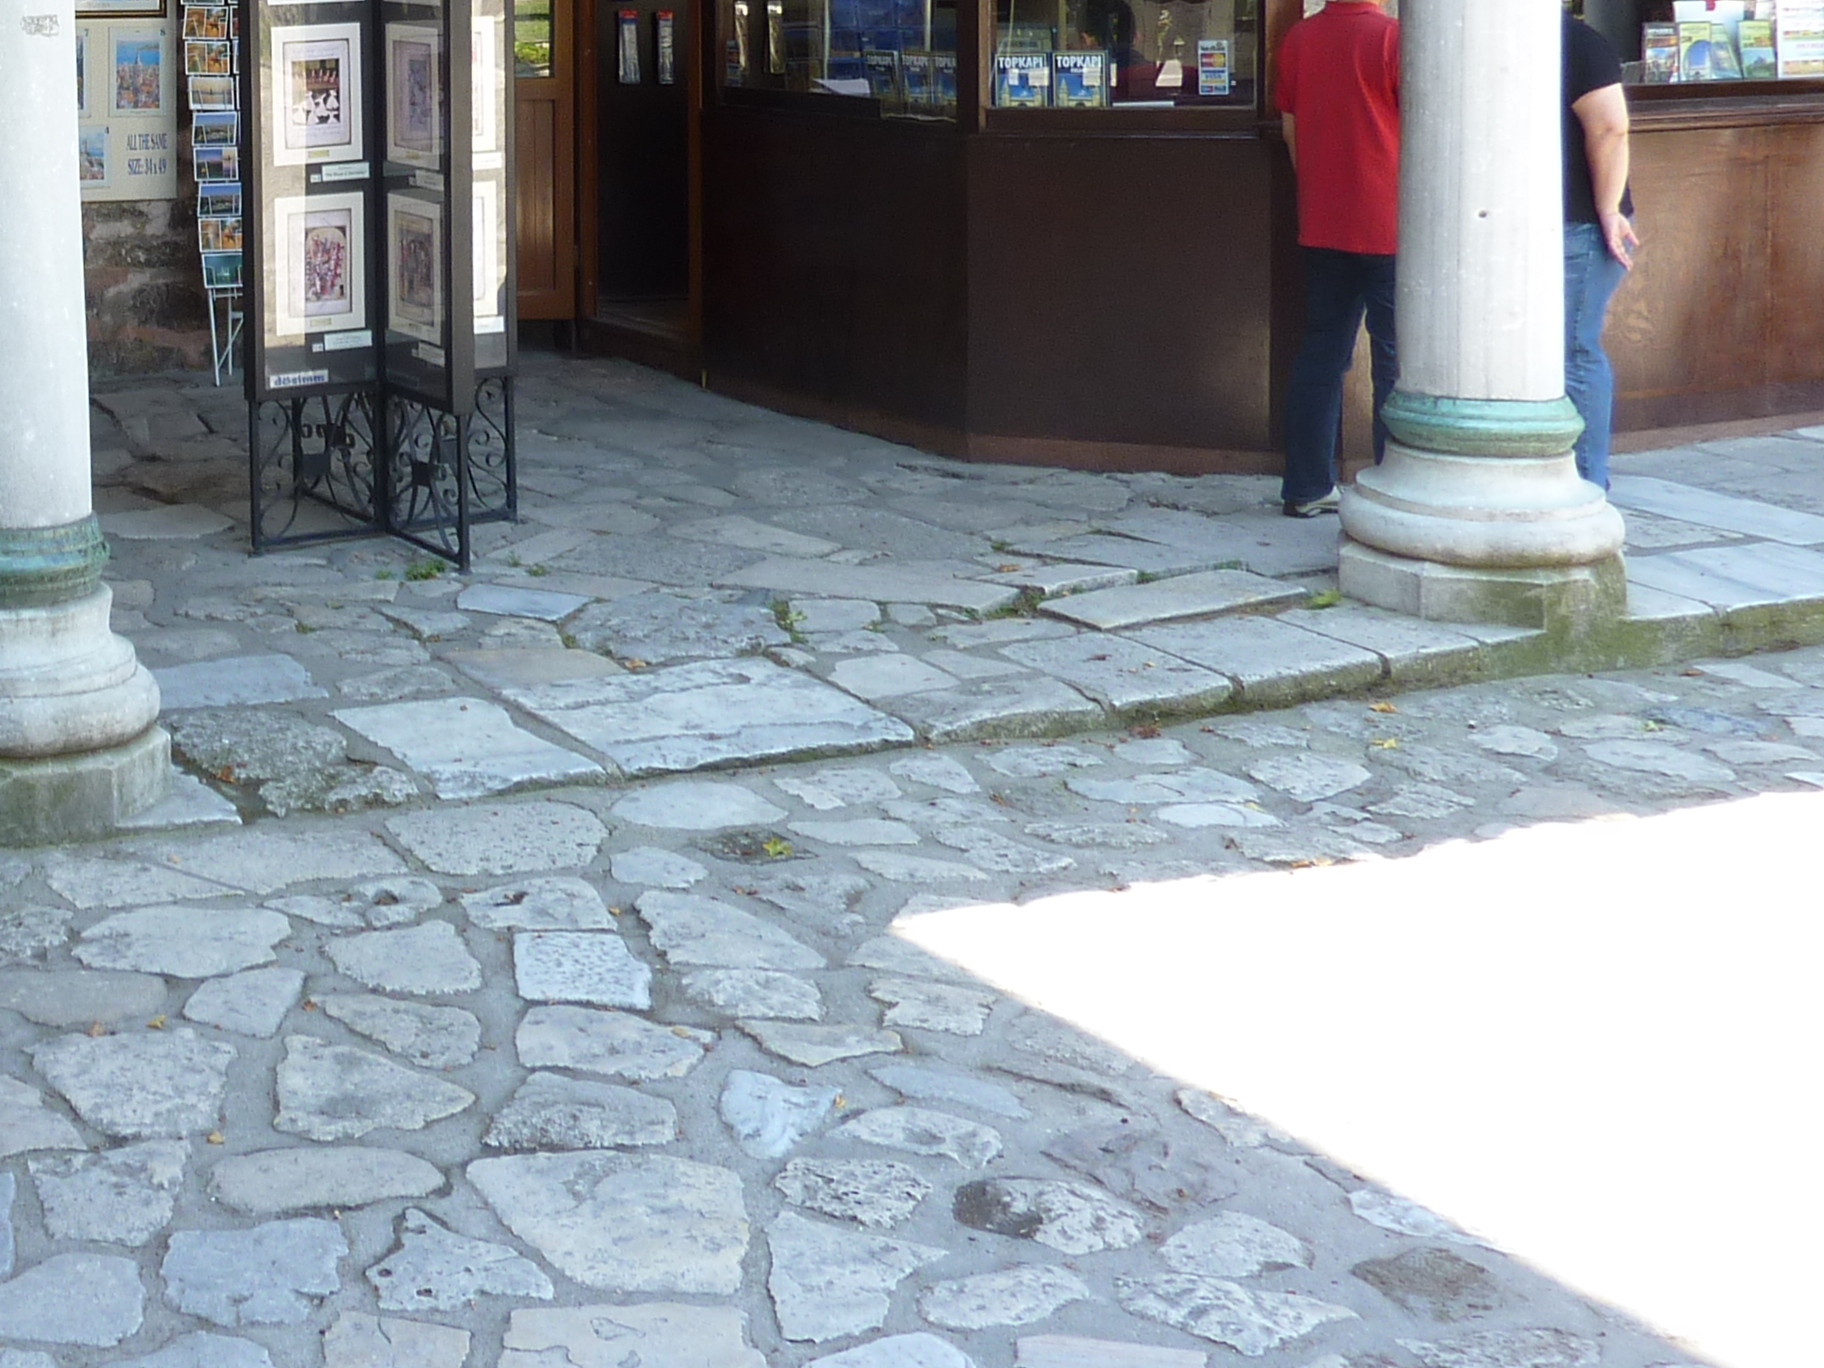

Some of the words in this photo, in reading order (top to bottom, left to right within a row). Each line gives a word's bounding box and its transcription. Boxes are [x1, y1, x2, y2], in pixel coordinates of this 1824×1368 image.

[998, 56, 1043, 68] TOPKAPI
[1056, 55, 1102, 68] TOPKAPI
[138, 133, 150, 150] THE
